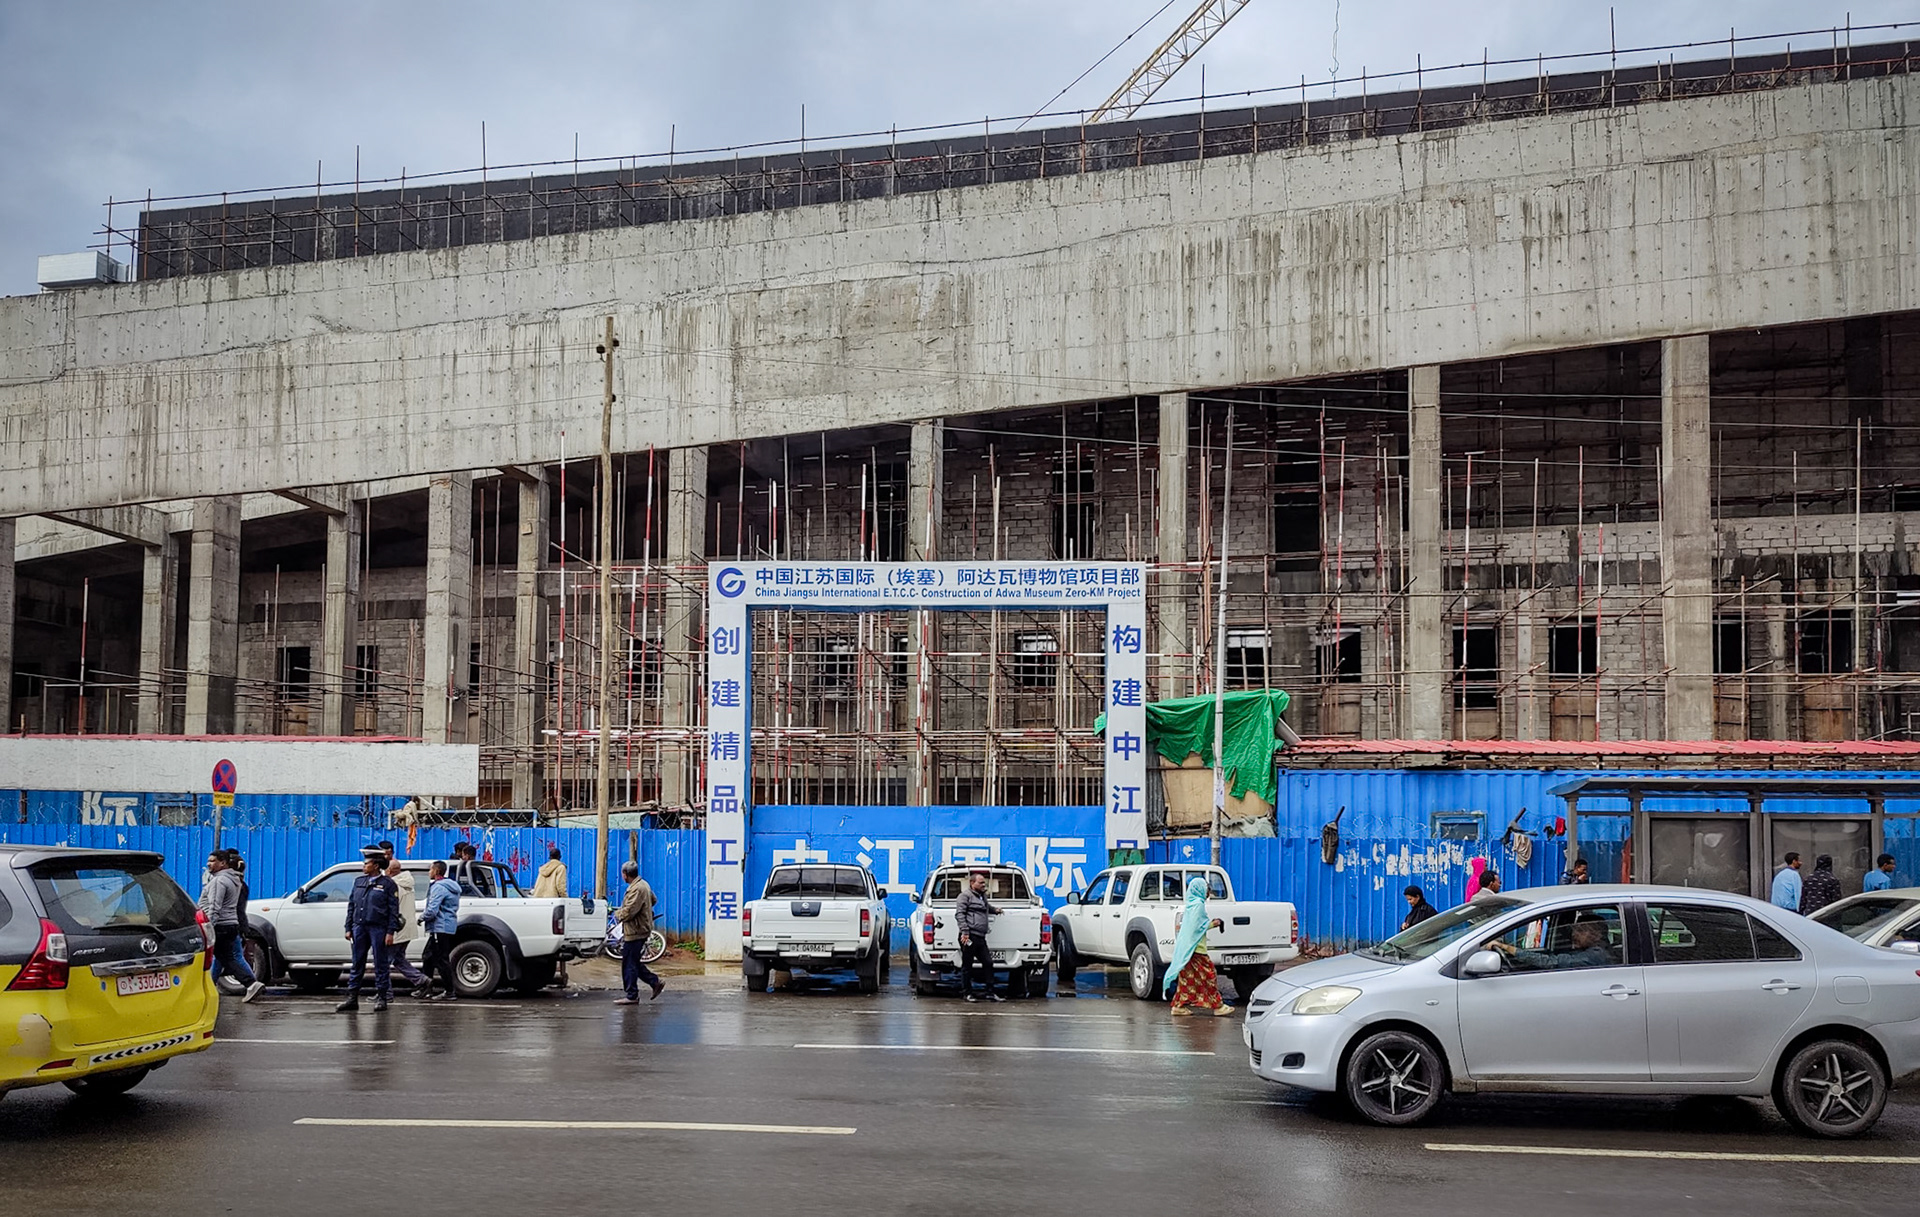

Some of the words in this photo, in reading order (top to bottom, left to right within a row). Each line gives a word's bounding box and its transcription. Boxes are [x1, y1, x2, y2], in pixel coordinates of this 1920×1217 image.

[755, 587, 781, 598] China
[783, 587, 819, 599] Jiangsu
[821, 587, 881, 598] International
[921, 587, 981, 598] Construction
[983, 587, 993, 598] of
[995, 587, 1021, 598] Adwa
[1024, 587, 1063, 598] Museum
[1065, 587, 1105, 598] Zero-KM
[1107, 587, 1141, 600] Project
[709, 626, 741, 921] 创建精品工程
